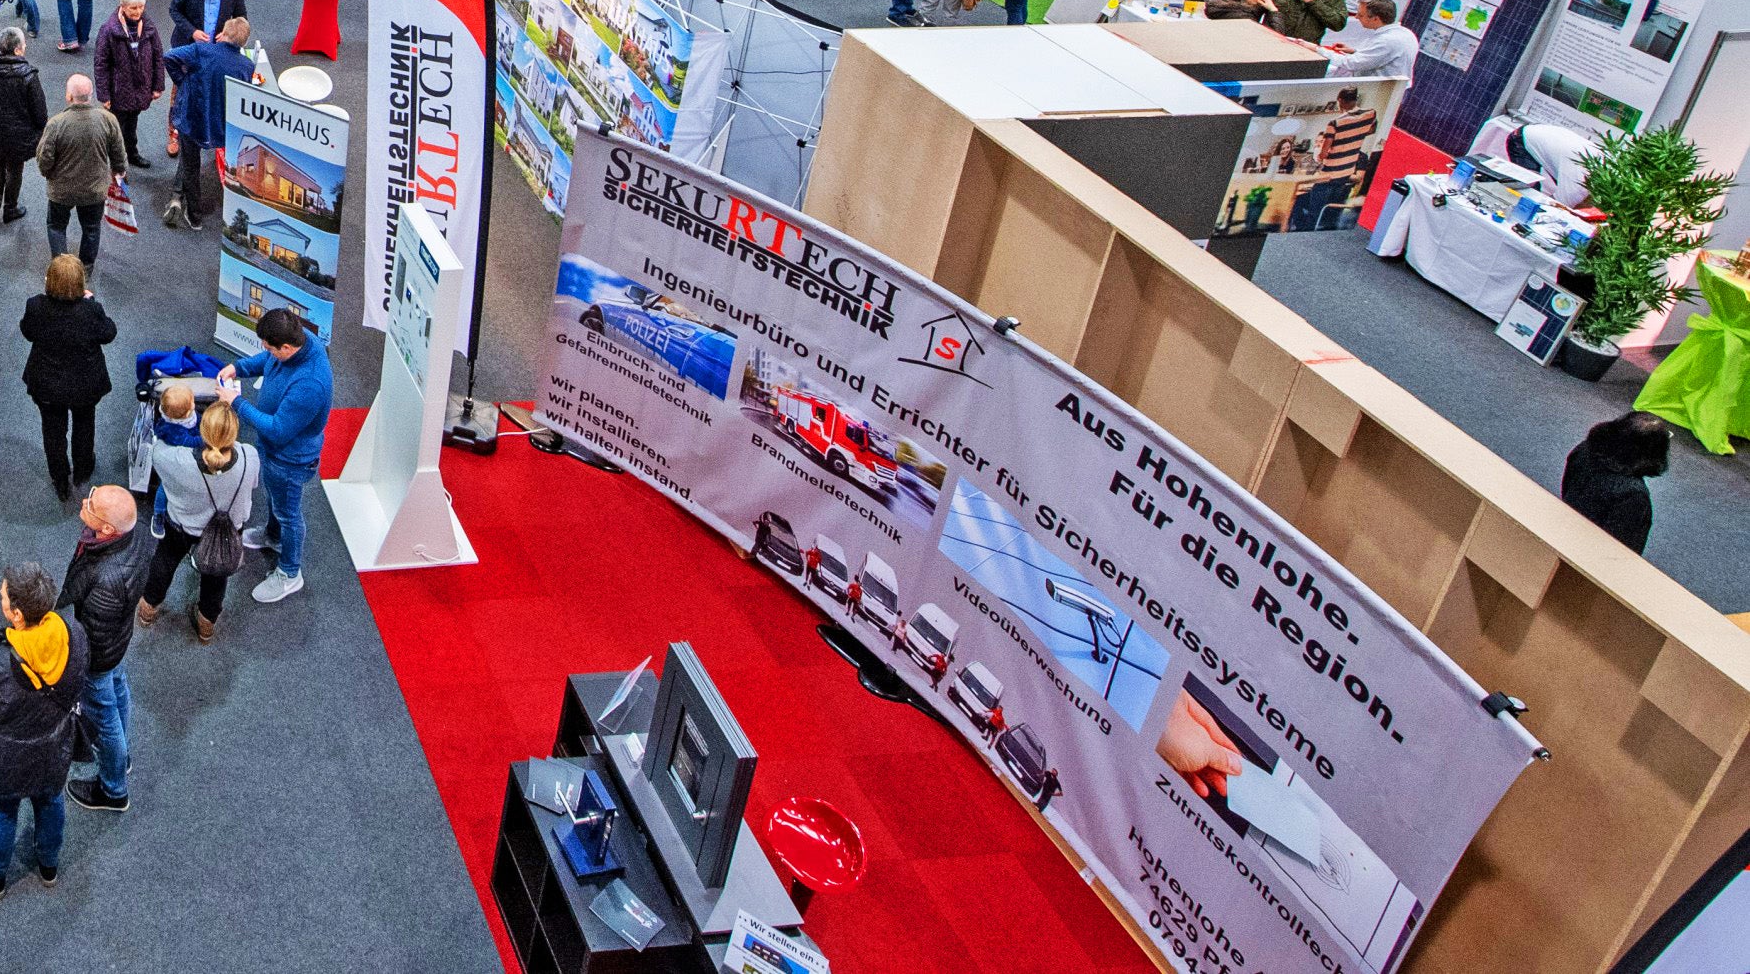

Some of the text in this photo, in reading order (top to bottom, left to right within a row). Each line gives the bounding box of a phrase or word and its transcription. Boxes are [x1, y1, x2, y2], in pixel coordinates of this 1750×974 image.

[603, 179, 893, 342] SICHERHEITSTECHNIK
[606, 147, 902, 318] SEKURTECH
[556, 333, 713, 427] Gefahrenmeldetechnik
[586, 330, 687, 393] Einbruch- und
[624, 314, 671, 354] POLIZEI
[548, 392, 672, 469] wir installieren.
[551, 376, 640, 430] wir planen.
[545, 409, 694, 504] wir halten instand.
[750, 433, 903, 546] Brandmeldetechnik
[642, 256, 1337, 782] Ingenieurbüro und Errichter für Sicherheitssysteme
[1056, 392, 1362, 646] Aus Hohenlohe.
[953, 576, 1112, 736] Videoüberwachung
[1109, 469, 1405, 745] Für die Region.
[750, 918, 815, 964] Wir stellen ein
[1128, 825, 1246, 967] Hohenlohe
[1139, 865, 1199, 944] 74629
